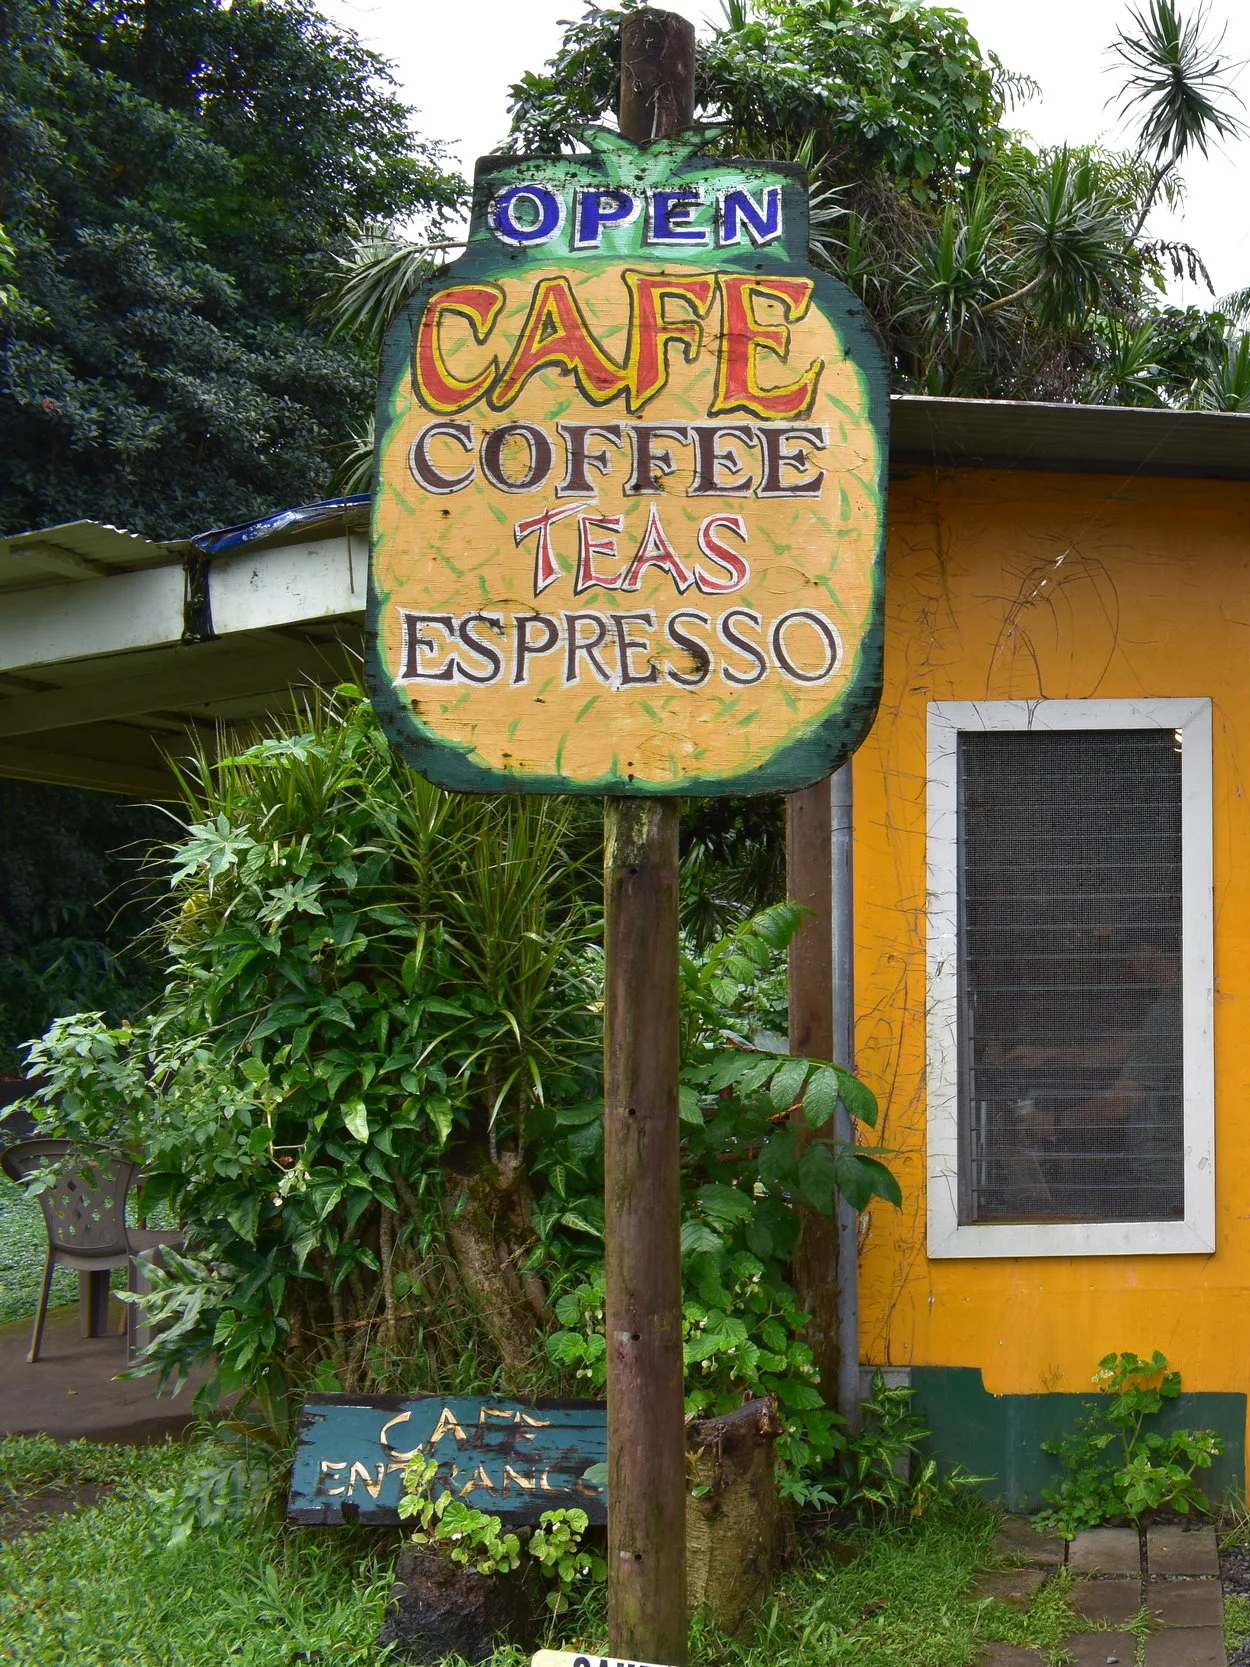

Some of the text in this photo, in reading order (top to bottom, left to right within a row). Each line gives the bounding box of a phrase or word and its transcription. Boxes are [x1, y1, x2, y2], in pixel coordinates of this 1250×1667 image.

[491, 184, 784, 251] OPEN
[412, 269, 824, 420] CAFE
[409, 420, 829, 498] COFFEE
[513, 500, 752, 597] TEAS
[393, 606, 843, 689] ESPRESSO
